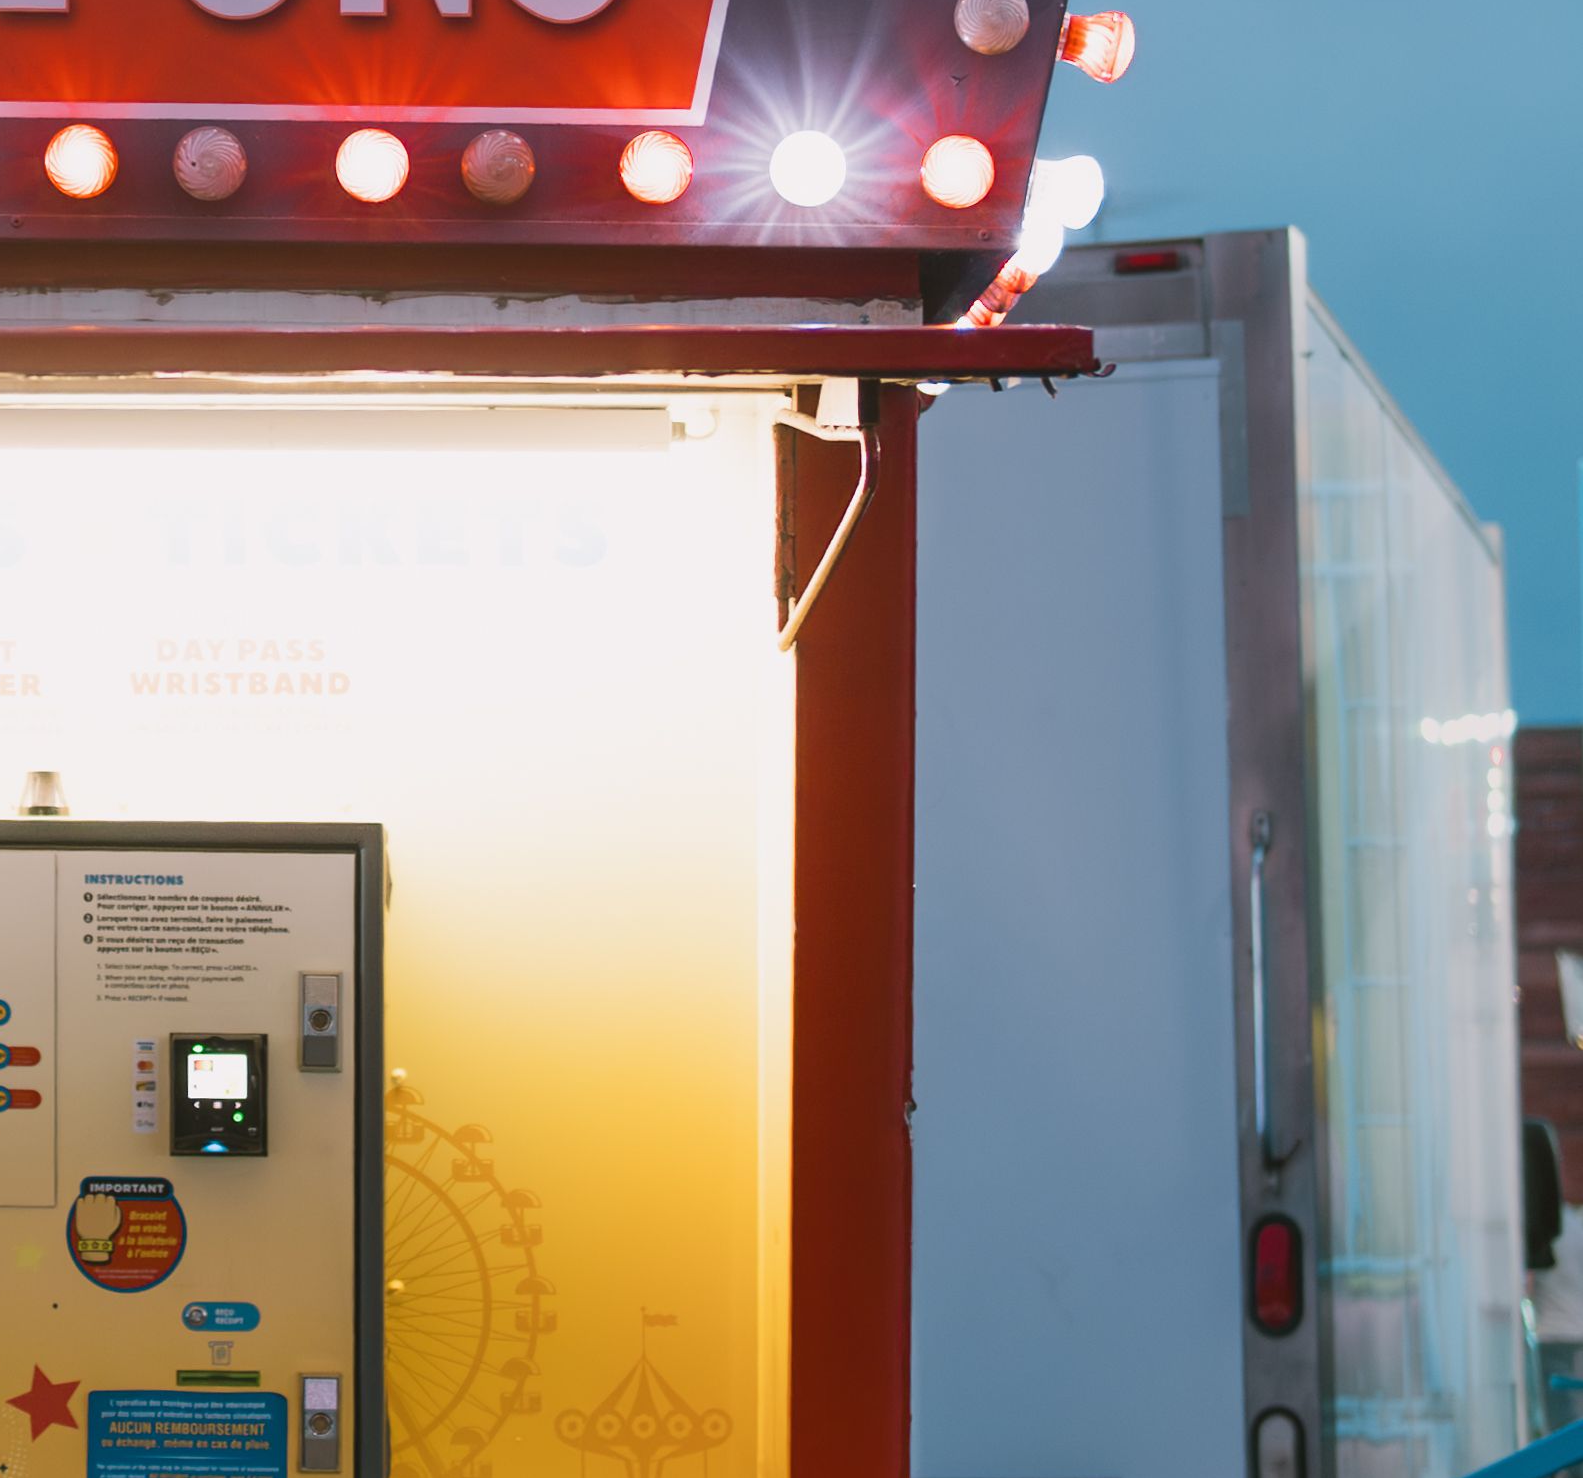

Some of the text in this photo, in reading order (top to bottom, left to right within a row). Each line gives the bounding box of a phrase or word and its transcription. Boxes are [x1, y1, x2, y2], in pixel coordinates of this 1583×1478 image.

[143, 494, 611, 570] TICKETS
[154, 638, 326, 665] DAY PASS
[128, 668, 354, 699] WRISTBAND
[84, 874, 185, 885] INSTRUCTIONS
[153, 905, 185, 913] appuyez
[97, 915, 128, 924] Lorsque
[89, 1183, 165, 1194] IMPORTANT
[129, 1210, 168, 1221] Bracelet
[109, 1421, 265, 1436] AUCUN REMBOURSEMENT
[211, 1441, 228, 1449] cas
